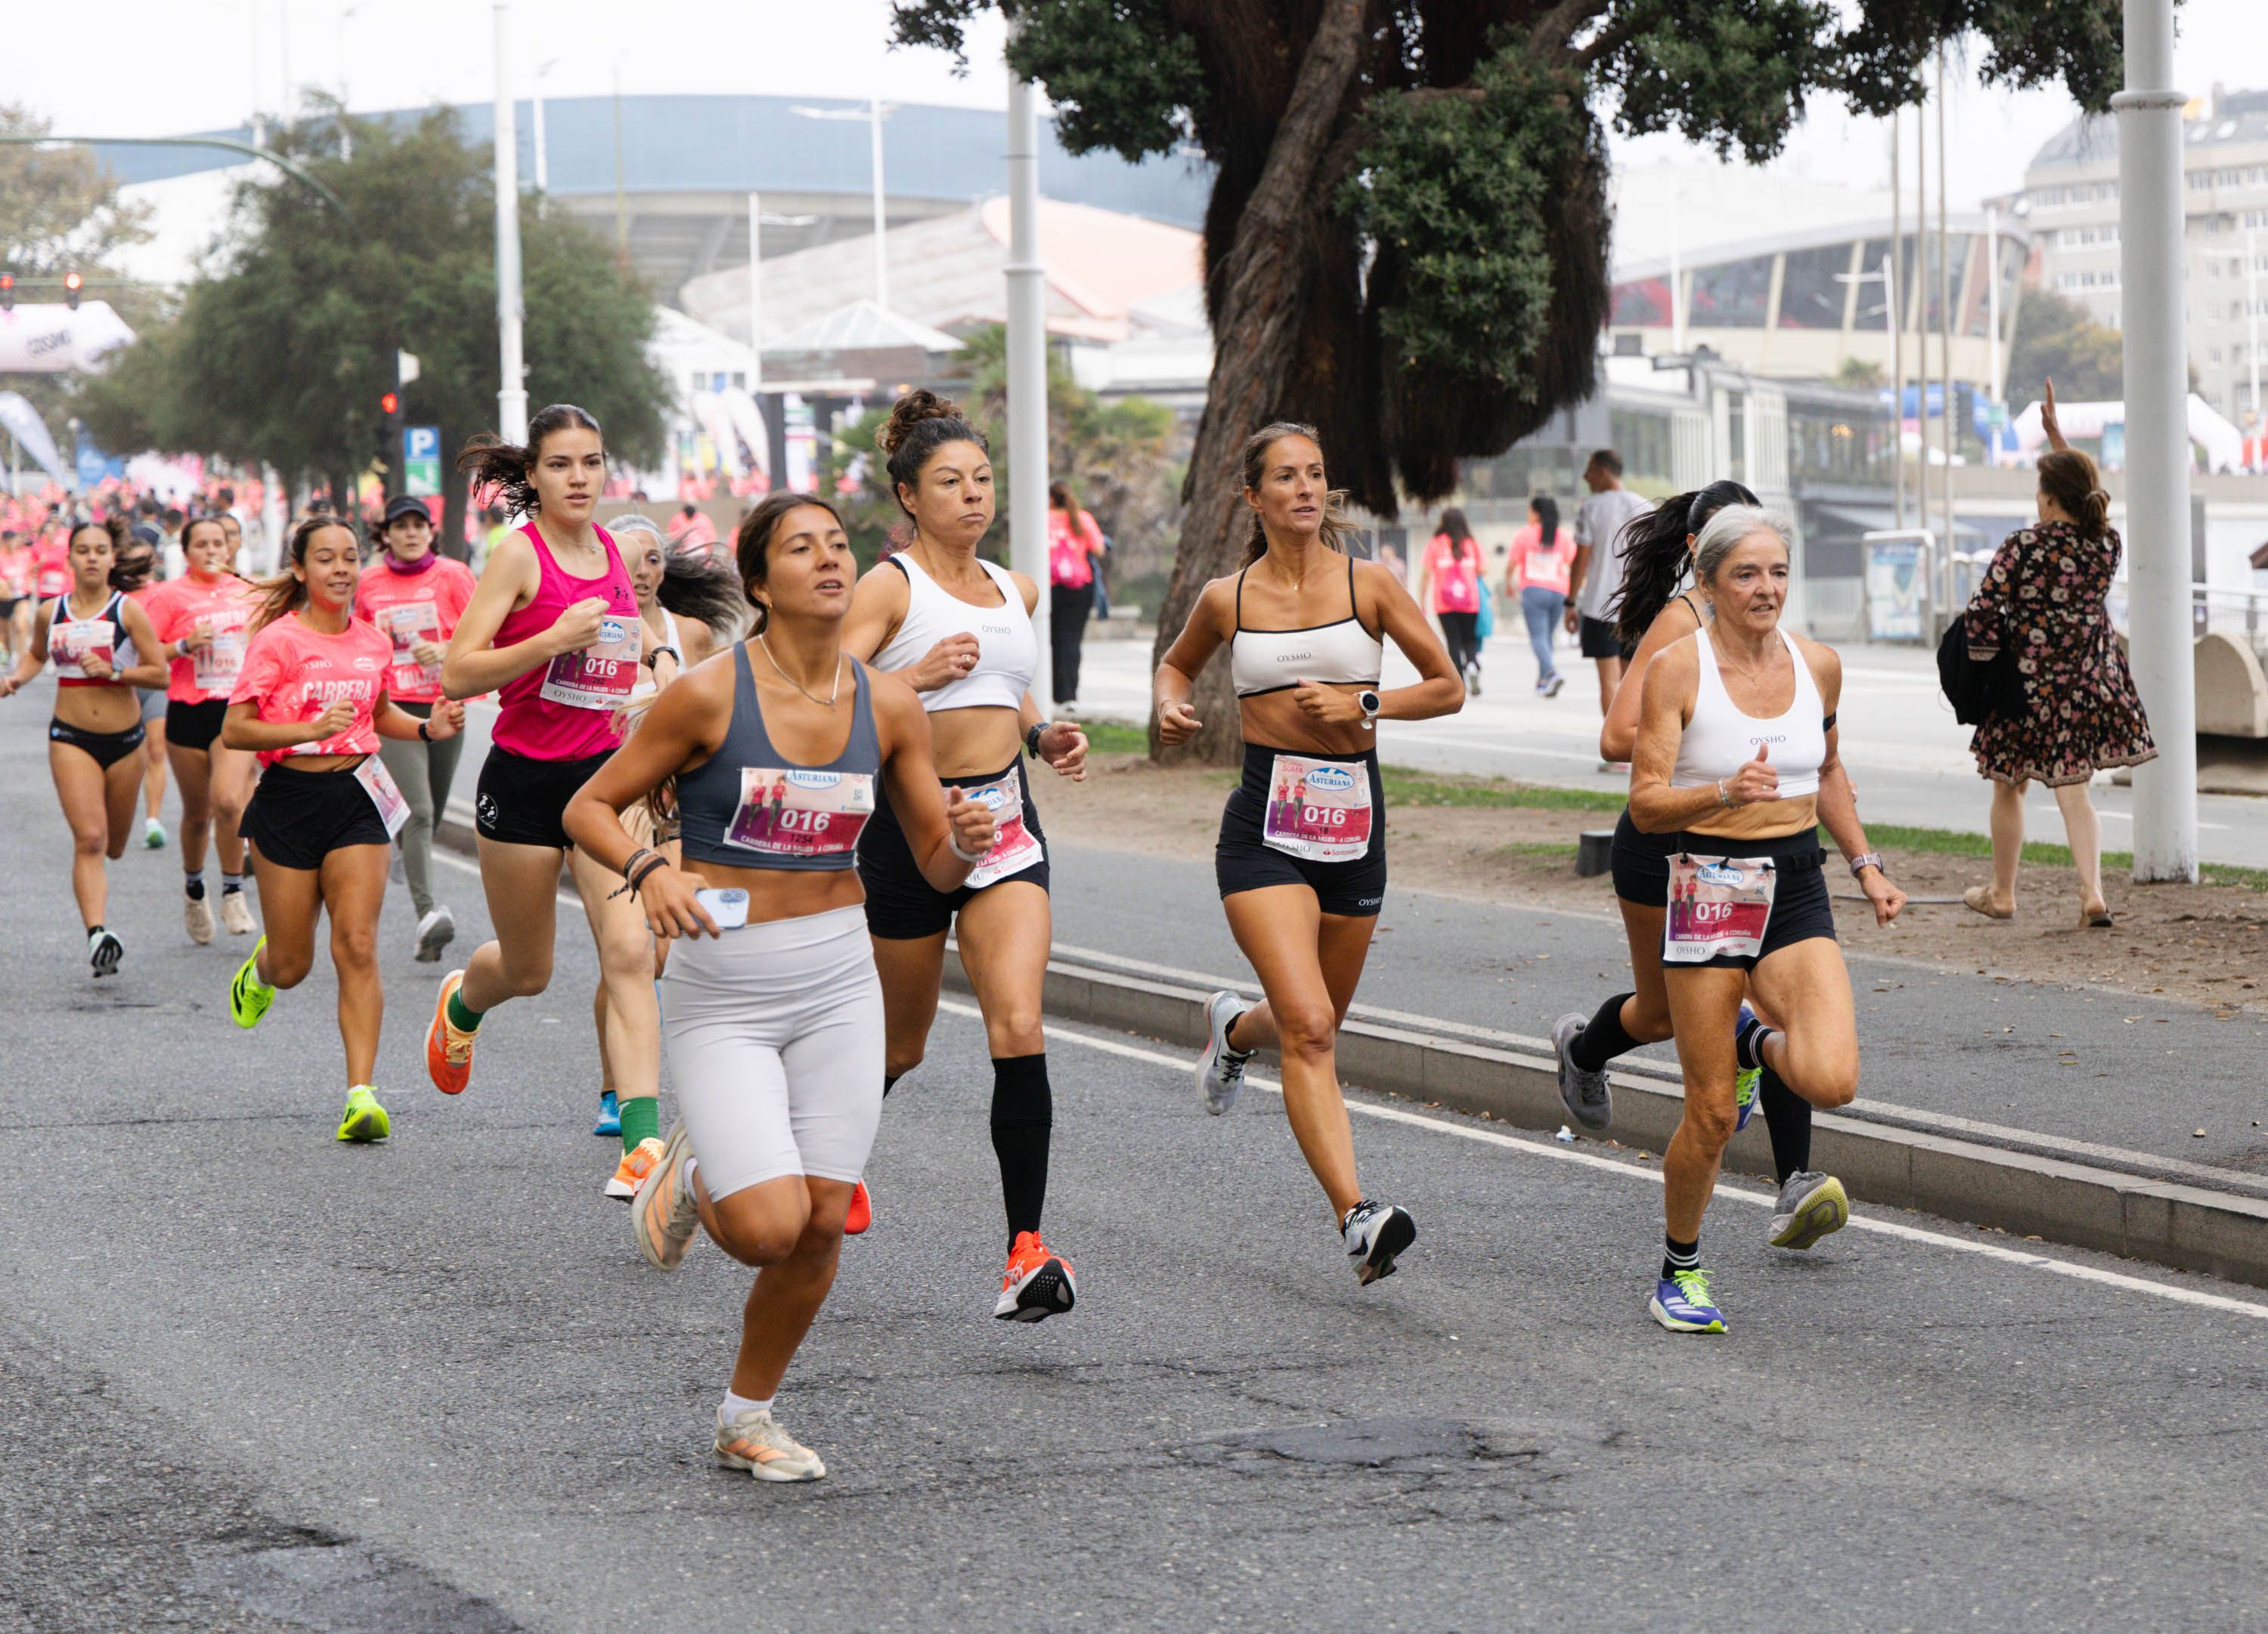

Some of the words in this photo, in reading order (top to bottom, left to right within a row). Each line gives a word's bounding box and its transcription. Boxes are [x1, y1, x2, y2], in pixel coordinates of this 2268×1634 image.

[411, 428, 434, 458] P
[982, 625, 1012, 635] OYSHO
[1277, 652, 1312, 662] OYSHO
[585, 658, 618, 676] 016
[556, 679, 578, 688] CARRERA
[302, 679, 371, 703] CARRERA
[553, 689, 587, 702] OYSHO
[1749, 734, 1786, 746] OYSHO
[791, 770, 838, 783] ASTURIANA
[1309, 774, 1352, 787] ASTURIANA
[780, 809, 831, 831] 016
[1304, 806, 1346, 826] 016
[790, 834, 814, 843] 1254
[1275, 830, 1300, 839] CARRERA
[741, 836, 771, 848] CARRERA
[772, 842, 782, 851] DE
[1359, 897, 1382, 907] OYSHO
[1696, 902, 1734, 921] 016
[1676, 946, 1706, 956] OYSHO
